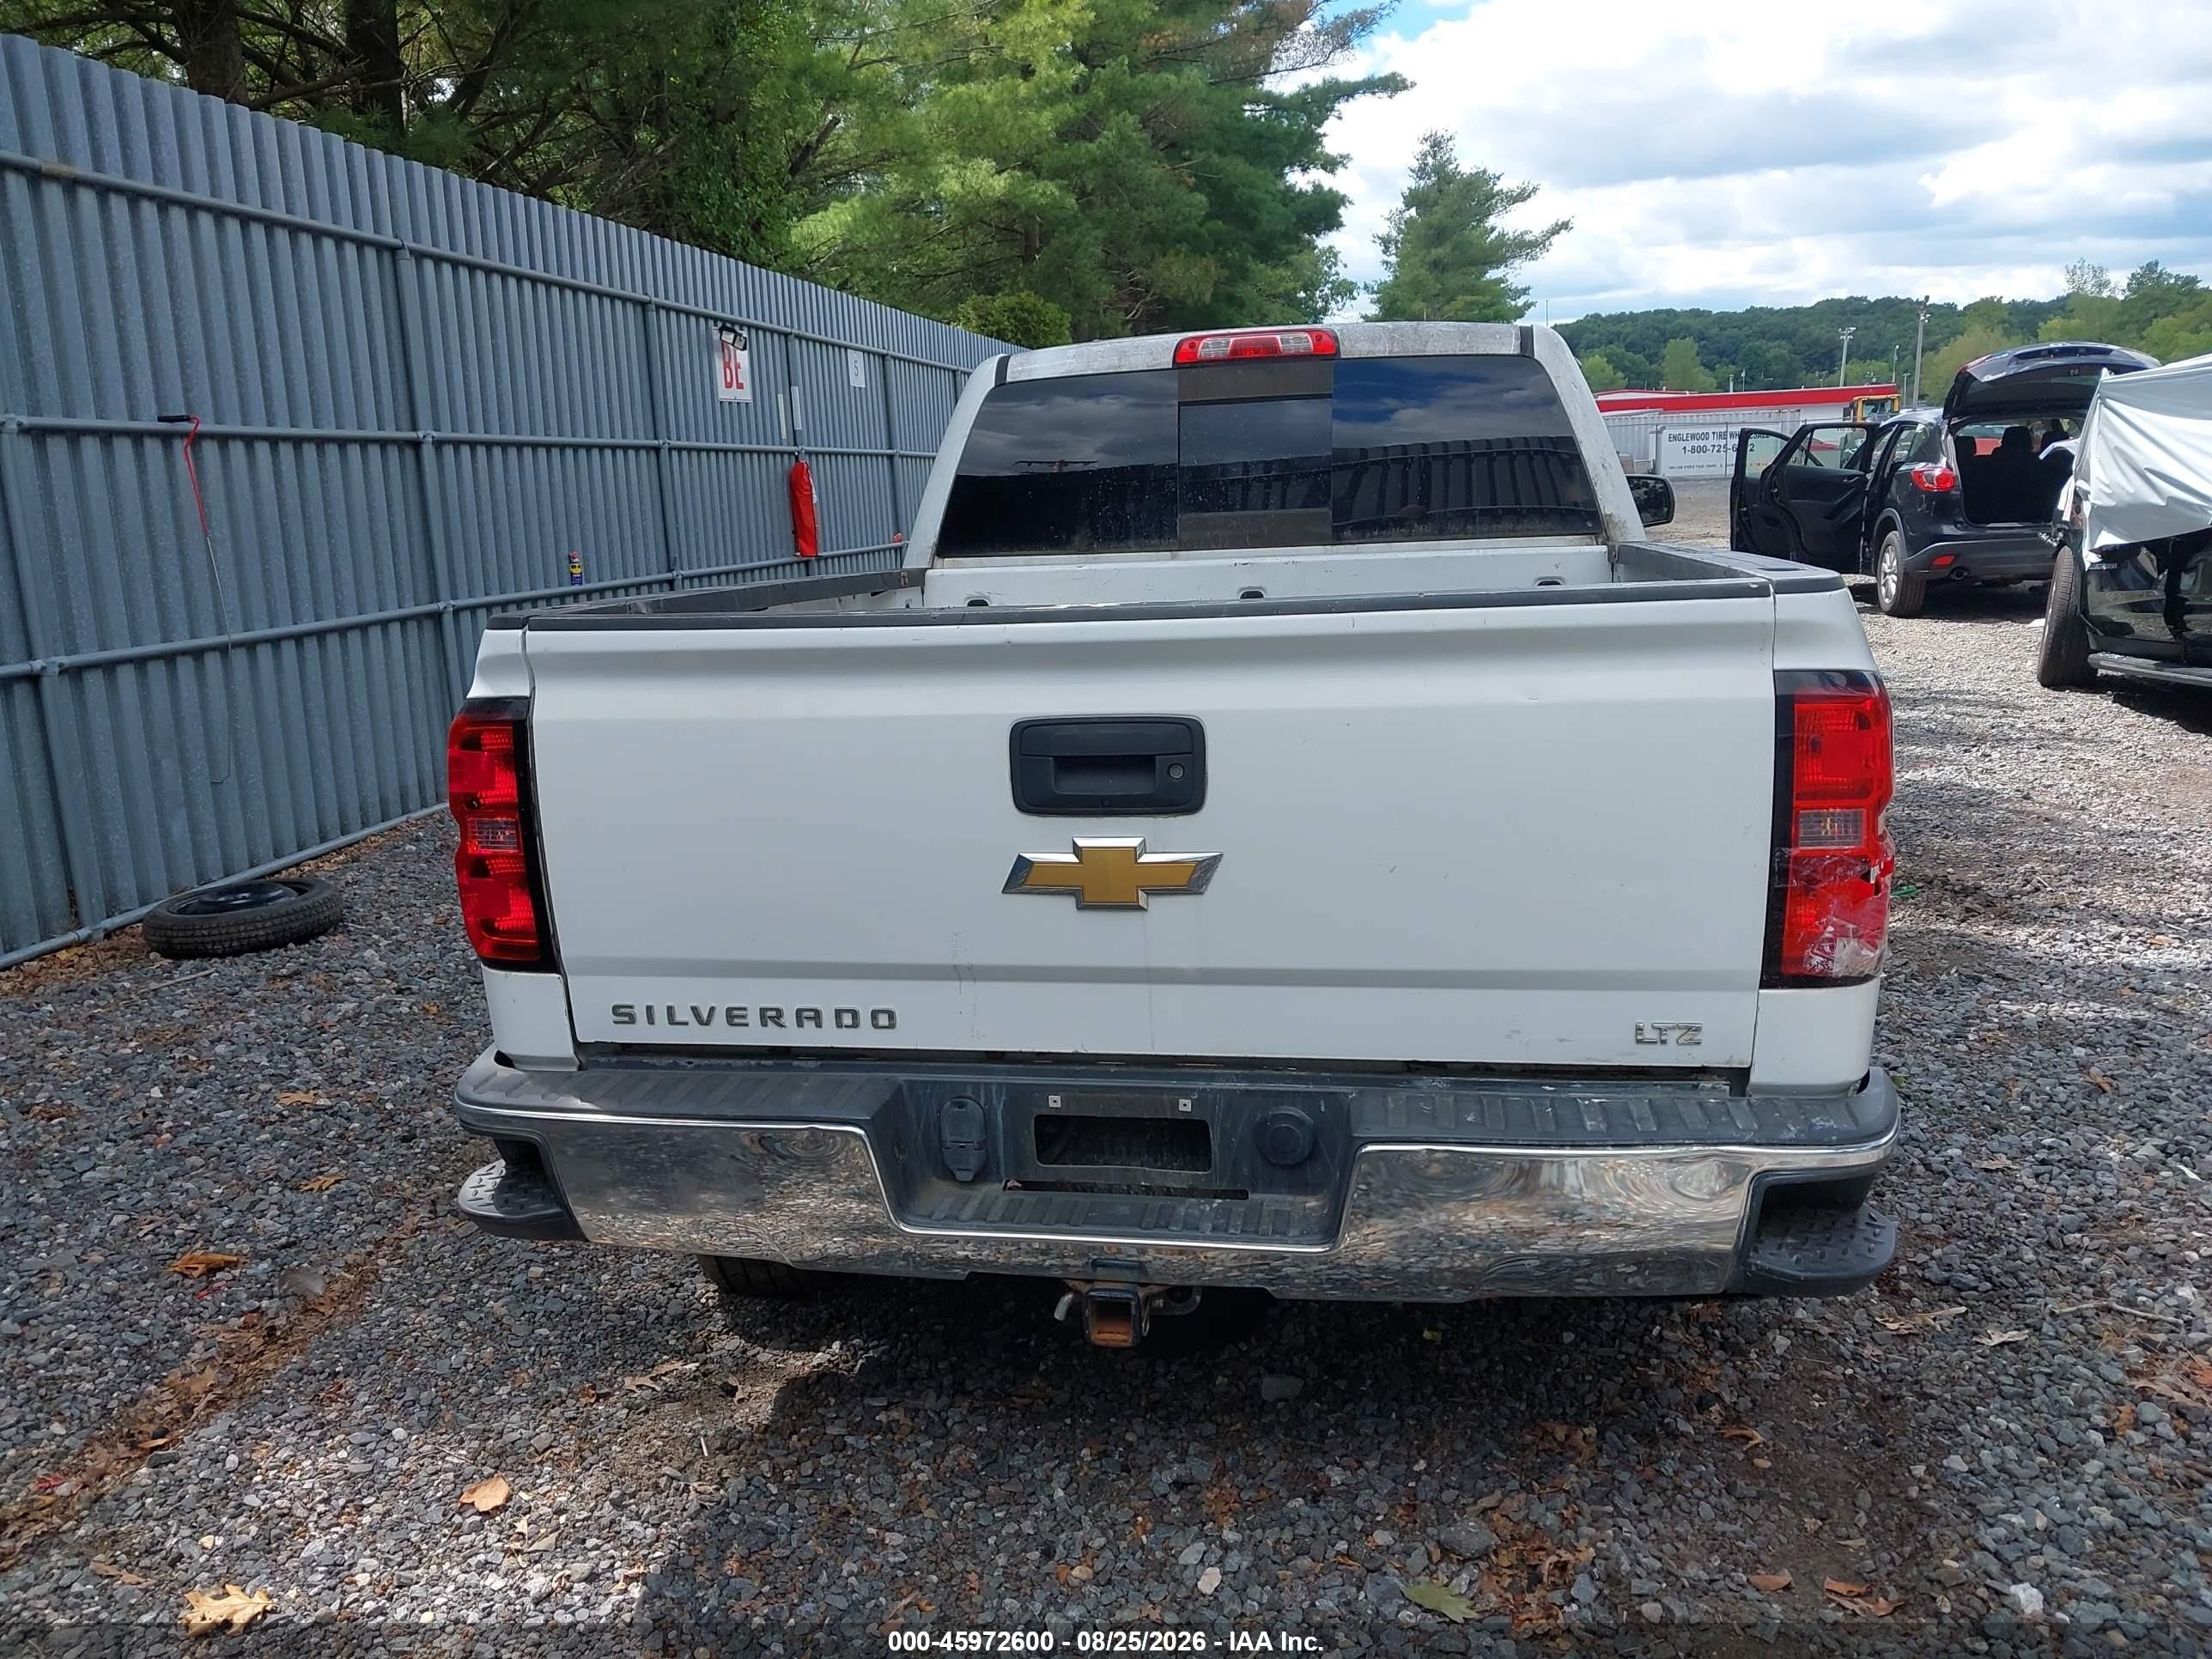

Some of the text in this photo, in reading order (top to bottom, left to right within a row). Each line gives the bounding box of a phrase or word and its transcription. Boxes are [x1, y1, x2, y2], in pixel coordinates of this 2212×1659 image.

[1668, 432, 1710, 442] ENGLEWOOD
[1711, 430, 1728, 441] TIRE
[1682, 443, 1755, 454] 1-800-725-62
[611, 1004, 898, 1030] SILVERADO
[1635, 1022, 1704, 1046] LTZ
